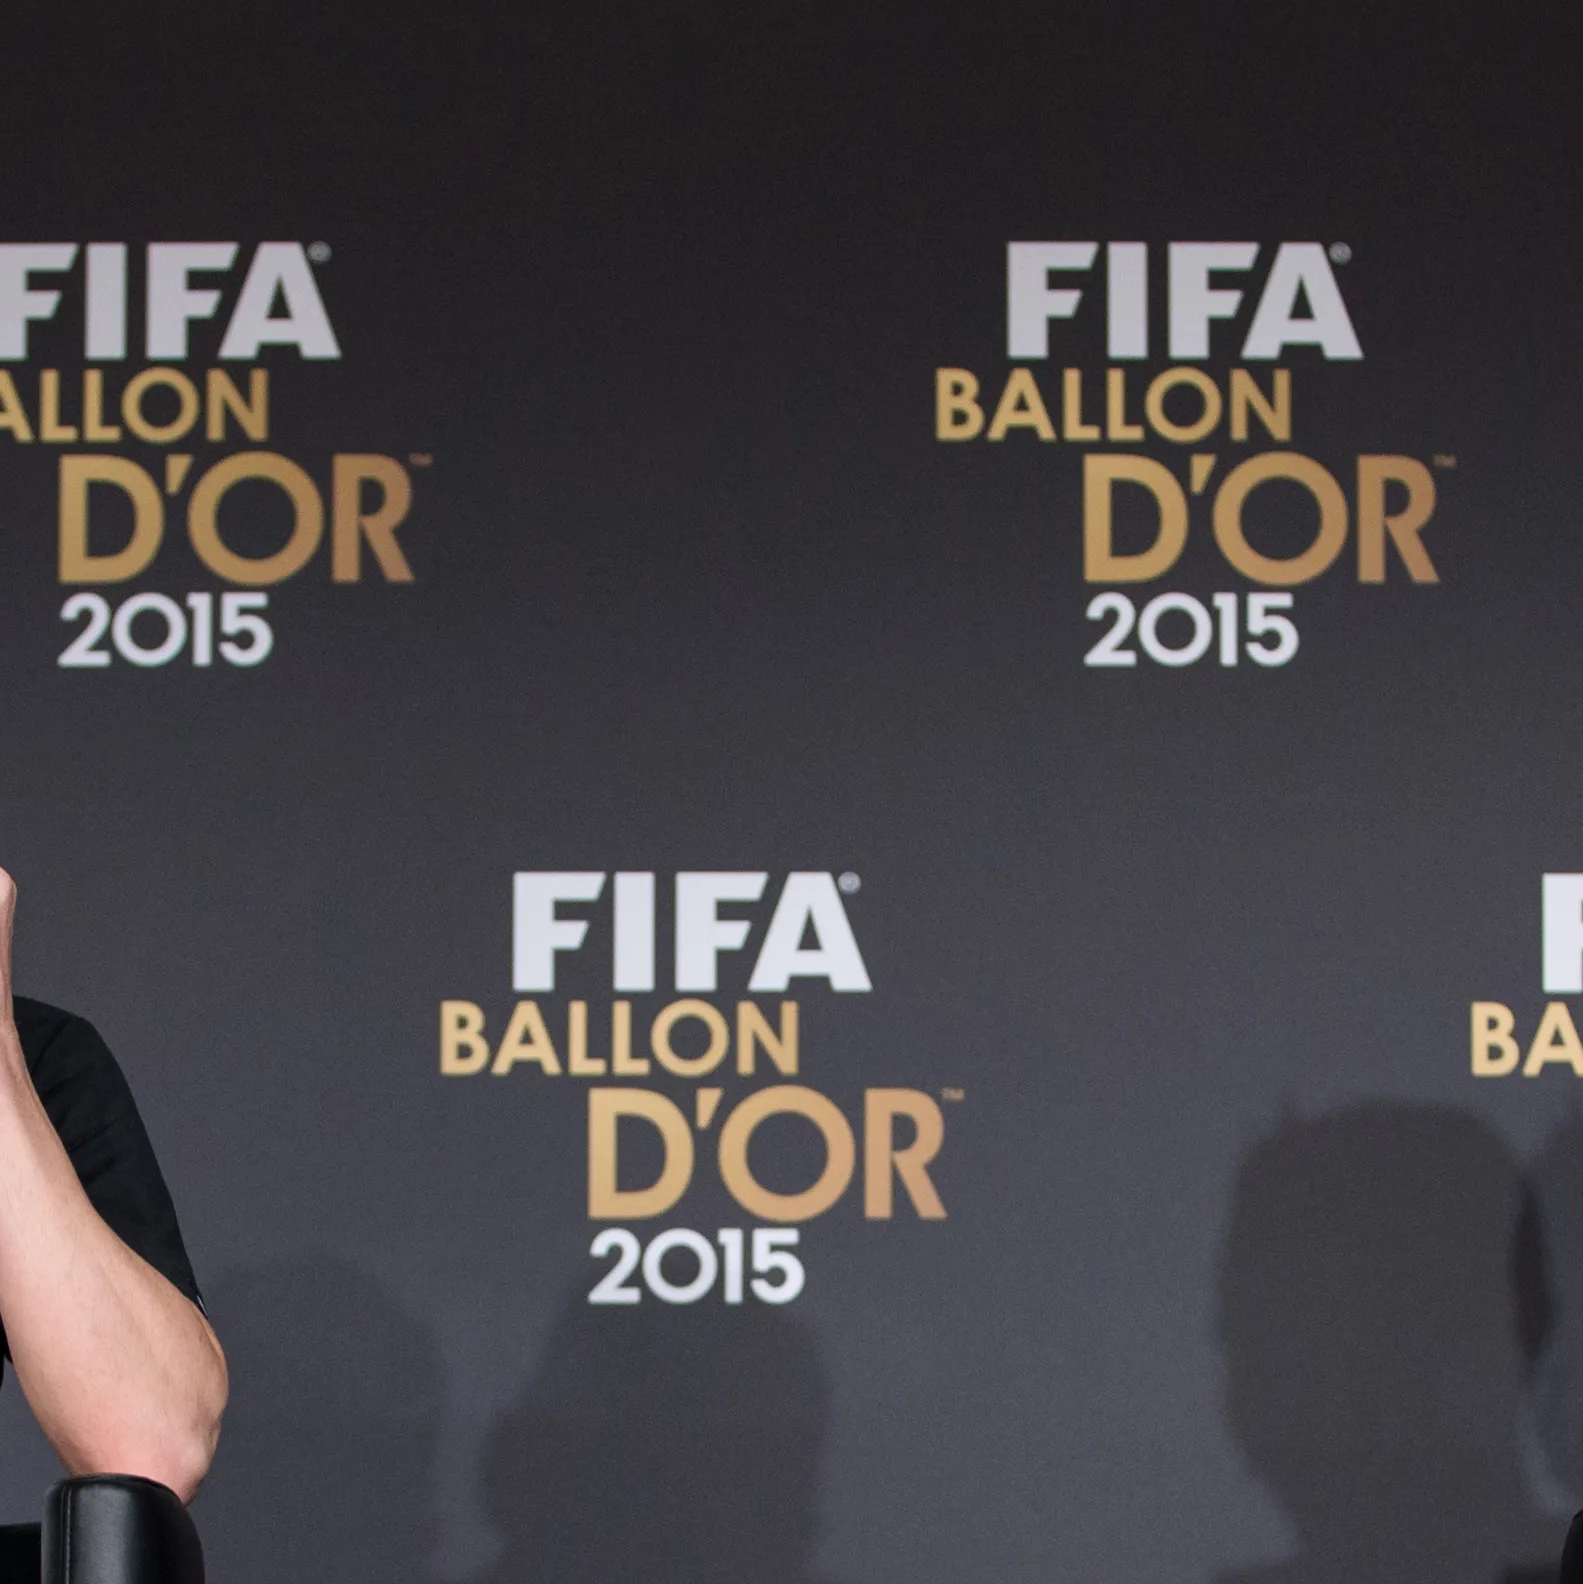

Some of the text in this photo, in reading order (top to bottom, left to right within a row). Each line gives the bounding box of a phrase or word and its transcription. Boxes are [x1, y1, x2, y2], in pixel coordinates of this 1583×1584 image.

[1006, 241, 1364, 360] FIFA
[934, 365, 1292, 444] BALLON
[57, 449, 414, 586] D'OR
[1082, 450, 1439, 586] D'OR
[56, 591, 274, 668] 2015
[1082, 590, 1301, 668] 2015
[510, 870, 874, 994] FIFA
[439, 997, 800, 1077] BALLON
[586, 1085, 946, 1223] D'OR
[586, 1227, 807, 1306] 2015
